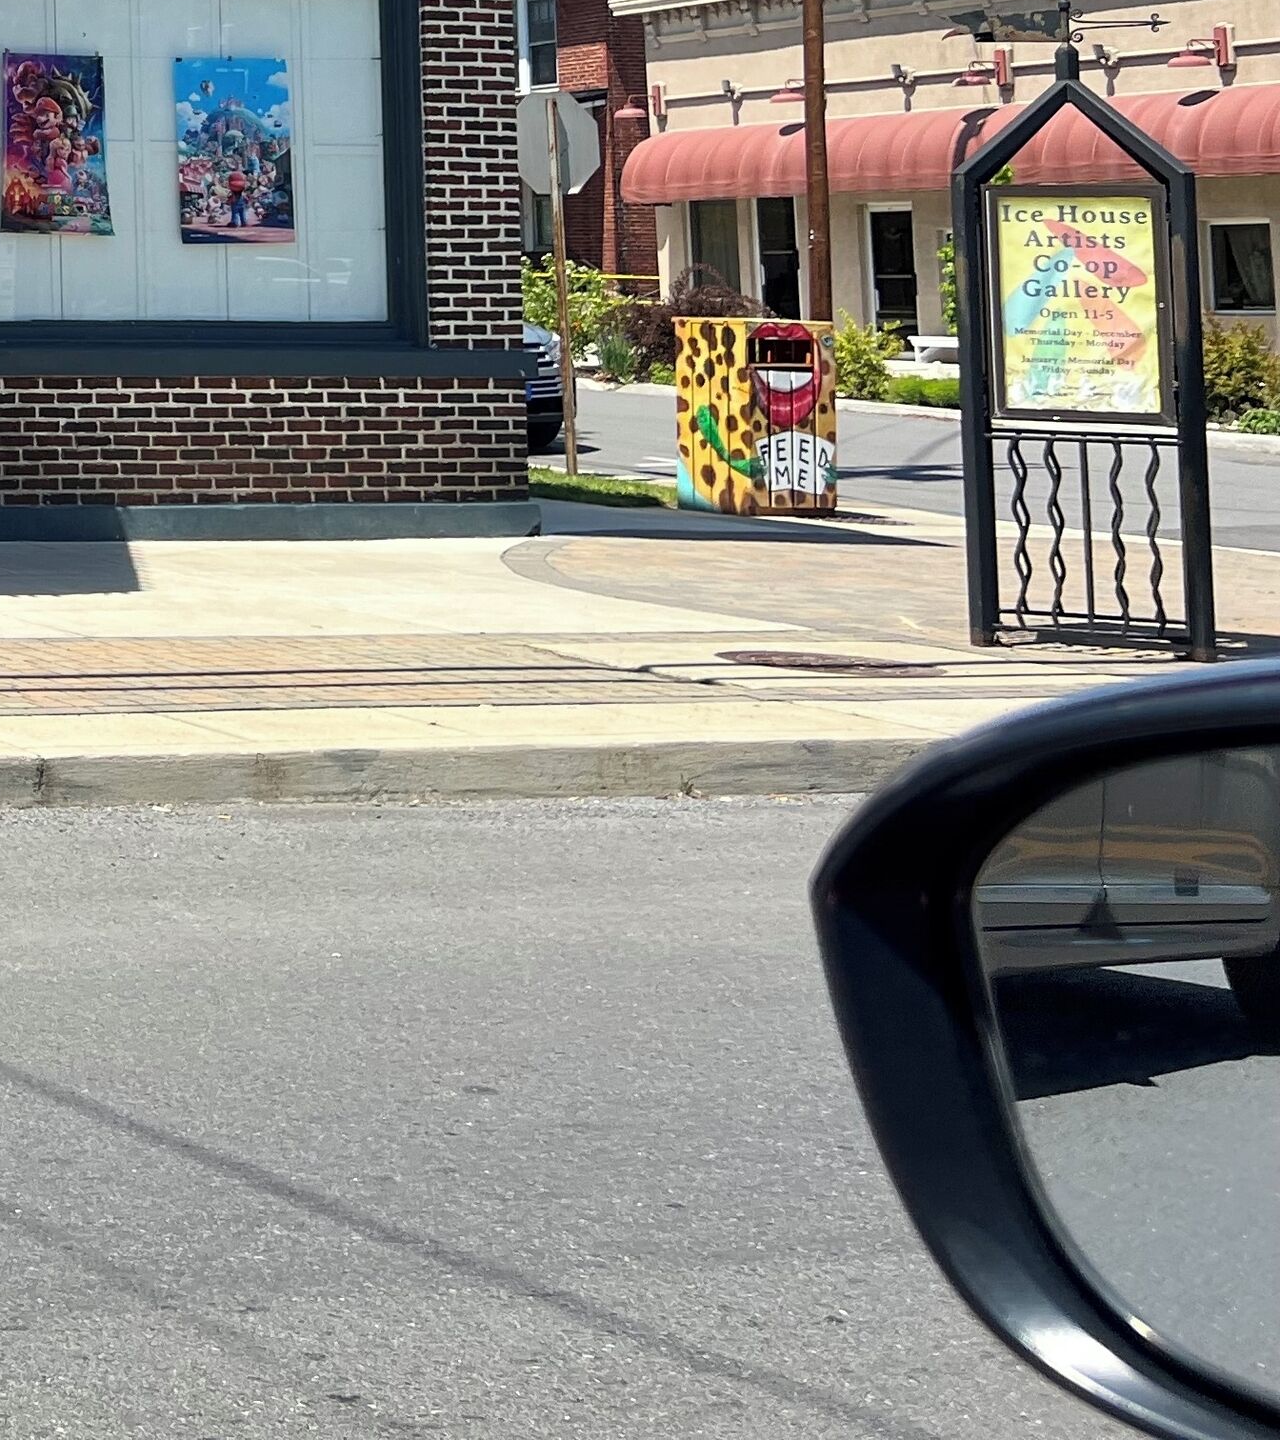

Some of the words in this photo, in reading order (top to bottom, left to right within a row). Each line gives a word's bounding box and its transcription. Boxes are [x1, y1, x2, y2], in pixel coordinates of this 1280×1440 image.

[1002, 204, 1044, 223] Ice
[1057, 205, 1148, 224] House
[1024, 230, 1126, 249] Artists
[1033, 255, 1118, 278] Co-op
[1022, 279, 1131, 303] Gallery
[1040, 308, 1077, 320] Open
[1084, 309, 1114, 320] 11-5
[760, 438, 831, 468] FEED
[775, 465, 808, 489] ME
